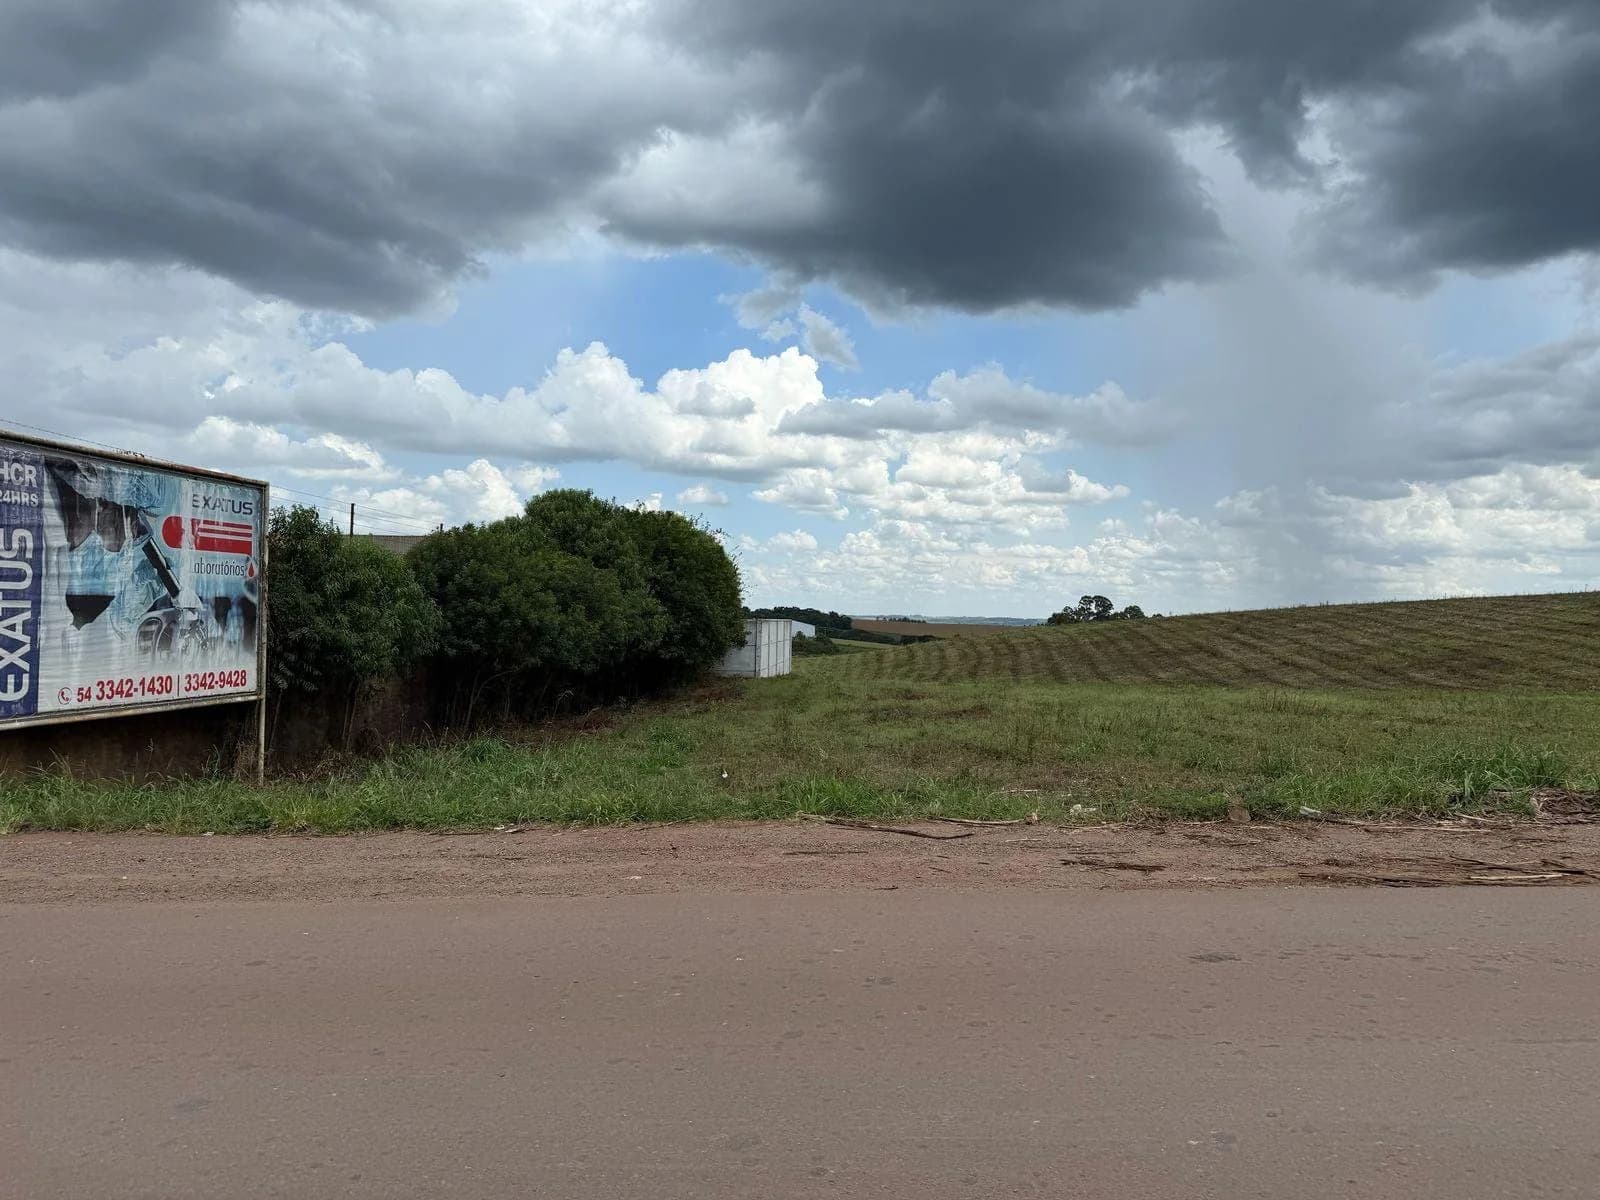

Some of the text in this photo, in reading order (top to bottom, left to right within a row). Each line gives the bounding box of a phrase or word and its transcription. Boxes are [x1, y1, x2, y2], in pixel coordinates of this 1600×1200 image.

[192, 493, 253, 515] EXATUS
[192, 557, 245, 576] aboratórios
[0, 528, 33, 702] EXATUS
[77, 669, 247, 702] 54 3342-1430 3342-9428
